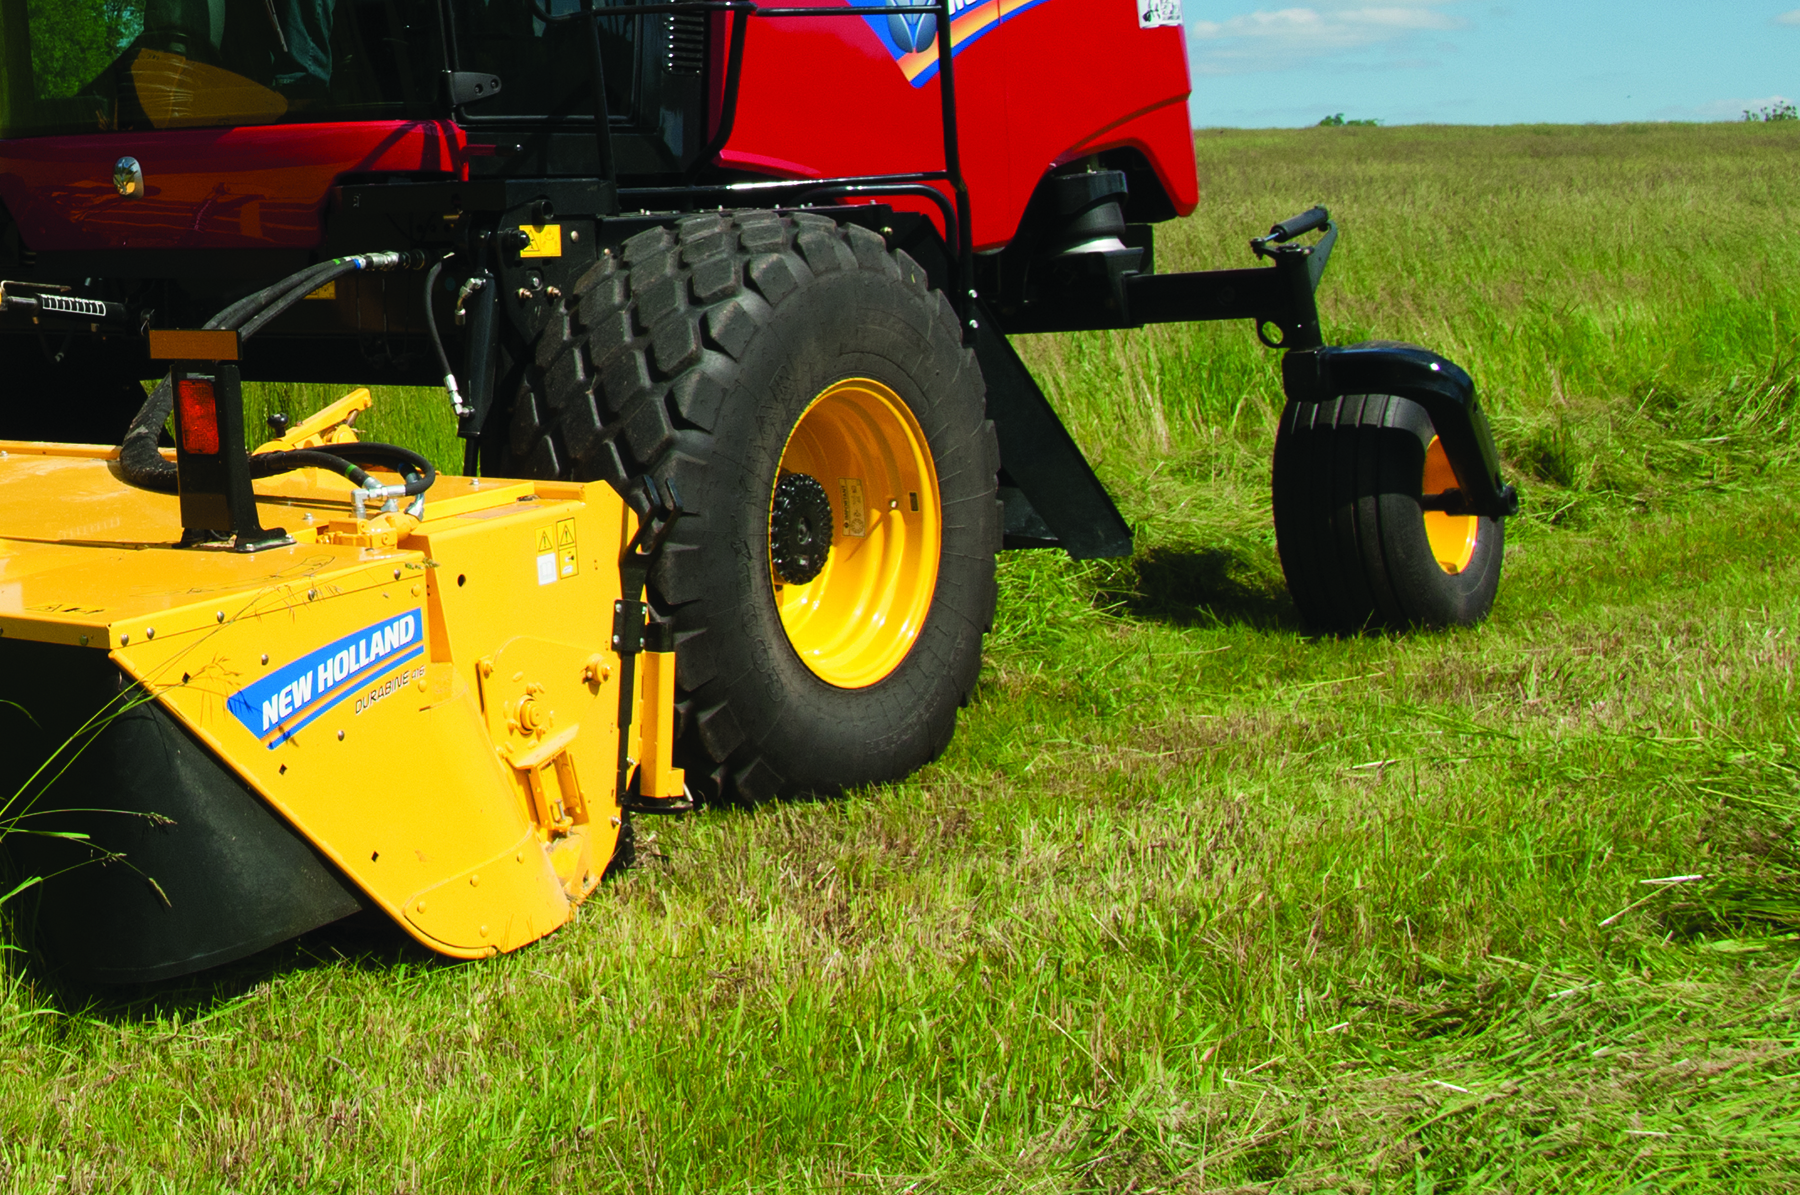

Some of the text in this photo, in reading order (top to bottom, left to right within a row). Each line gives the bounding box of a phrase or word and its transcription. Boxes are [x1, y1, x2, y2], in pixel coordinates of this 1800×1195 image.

[262, 614, 415, 732] NEW HOLLAND
[355, 670, 410, 715] DURABINE
